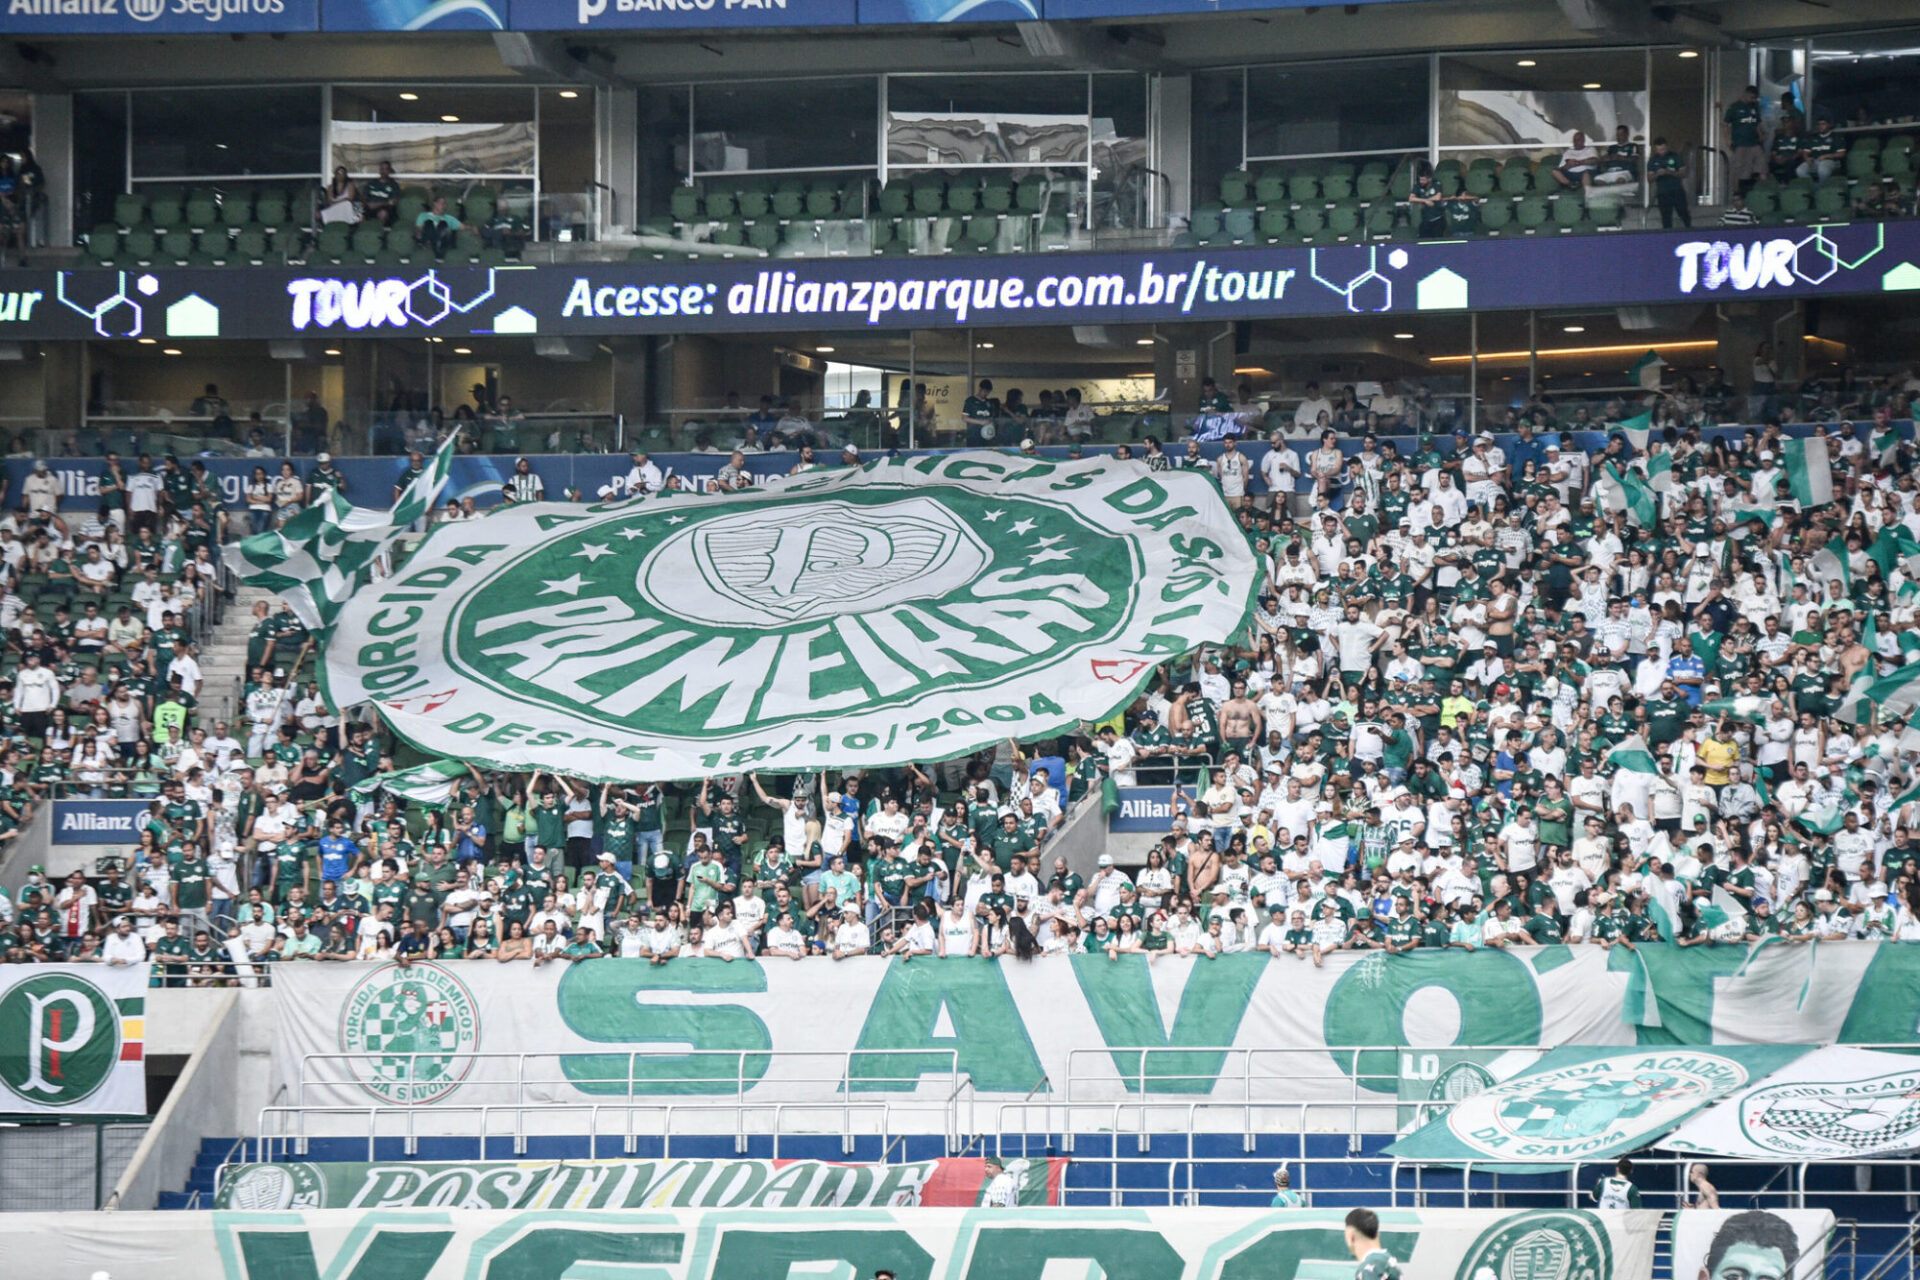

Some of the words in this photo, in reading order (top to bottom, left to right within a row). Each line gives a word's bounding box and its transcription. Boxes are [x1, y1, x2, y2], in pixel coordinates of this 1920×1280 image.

[561, 277, 717, 318] Acesse:
[727, 260, 1295, 325] allianzparque.com.br/tour
[1674, 238, 1797, 293] TOUR
[287, 276, 409, 330] TOUR
[358, 544, 510, 701] TORCIDA
[1102, 476, 1199, 532] DA
[474, 566, 1111, 731] PALMEIRAS
[699, 692, 1065, 768] 18/10/2004
[61, 812, 132, 830] Allianz
[346, 982, 378, 1048] TORCIDA
[392, 966, 473, 1042] ACADEMICOS
[1470, 1126, 1511, 1148] DA
[348, 1157, 938, 1208] POSITIVIDADE
